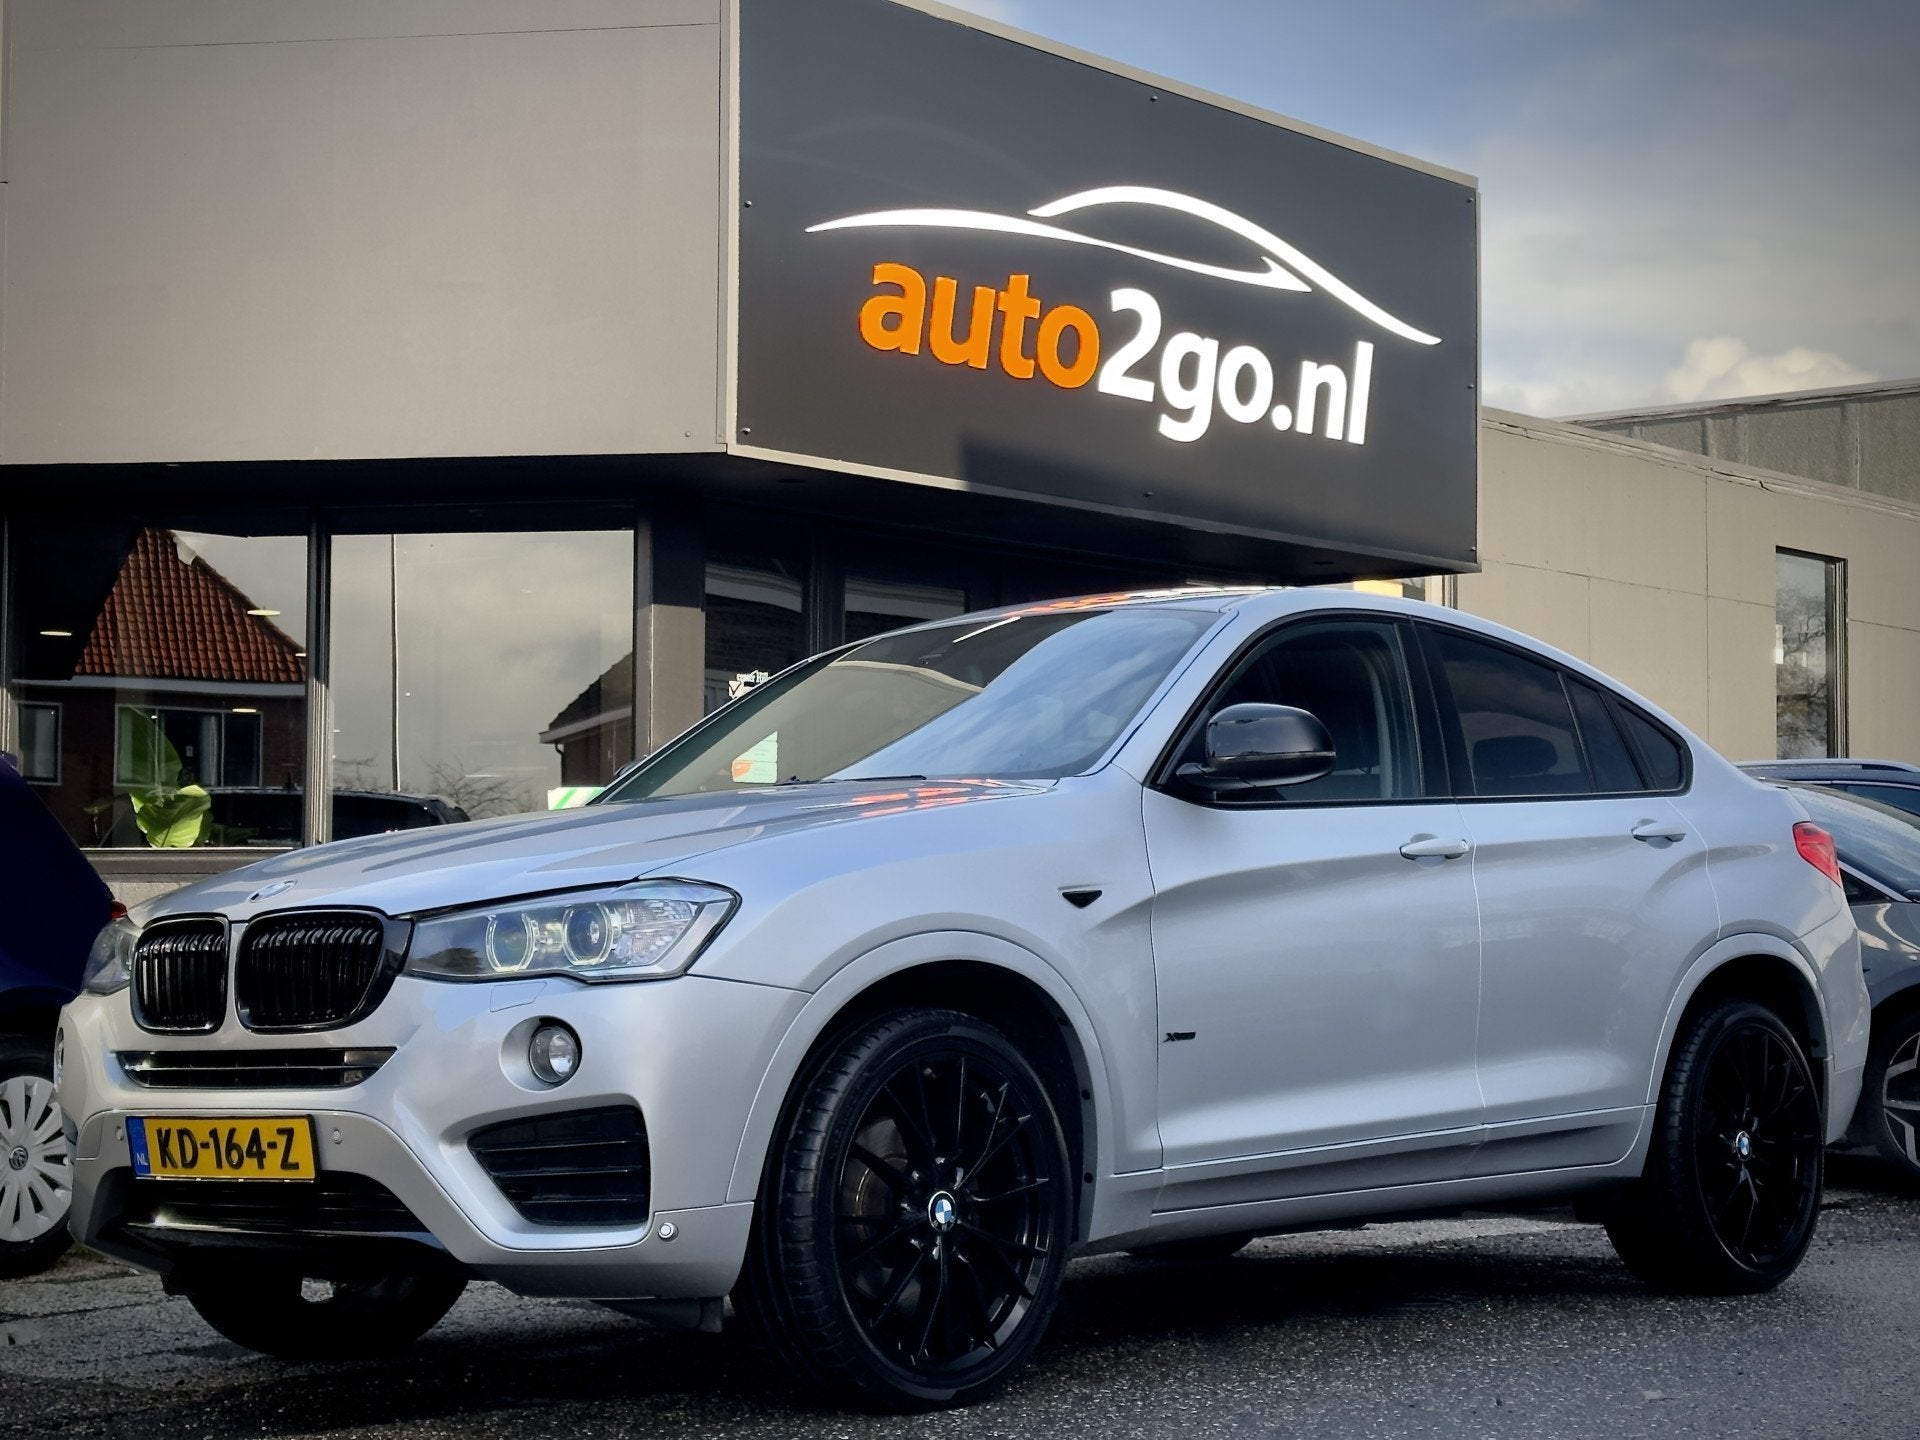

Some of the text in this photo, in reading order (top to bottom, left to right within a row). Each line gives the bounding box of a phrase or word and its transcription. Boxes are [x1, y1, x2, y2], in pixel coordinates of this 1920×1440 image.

[857, 262, 1374, 445] auto2go.nl
[136, 1152, 149, 1166] NL
[156, 1127, 300, 1170] KD-164-Z
